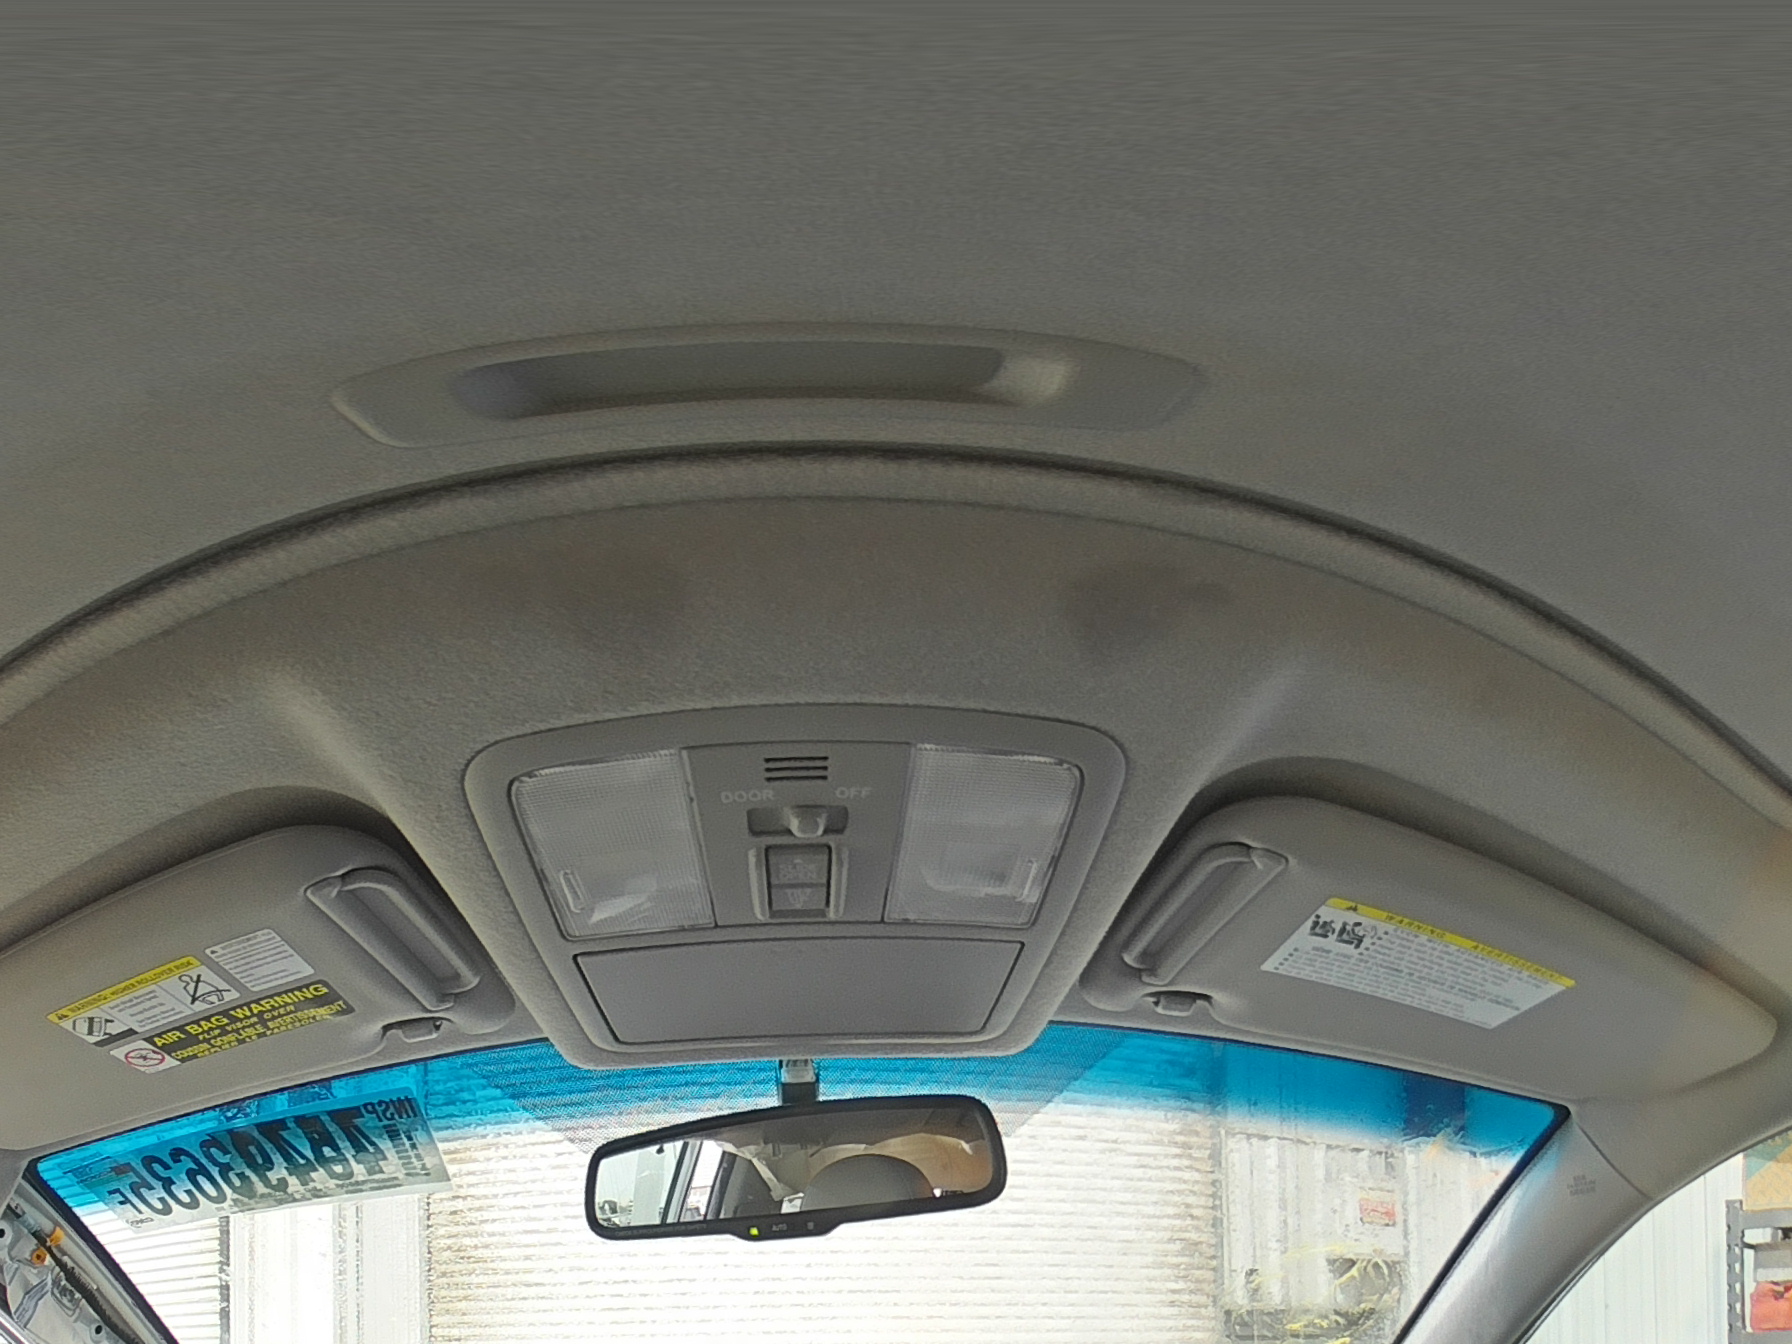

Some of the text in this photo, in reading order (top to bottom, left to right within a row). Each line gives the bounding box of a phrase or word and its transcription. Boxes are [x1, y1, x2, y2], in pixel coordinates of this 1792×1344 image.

[720, 789, 775, 803] DOOR
[835, 786, 872, 799] OFF
[153, 983, 329, 1047] AIR BAG WARNING
[198, 1004, 295, 1041] FLIP VISOR OVER
